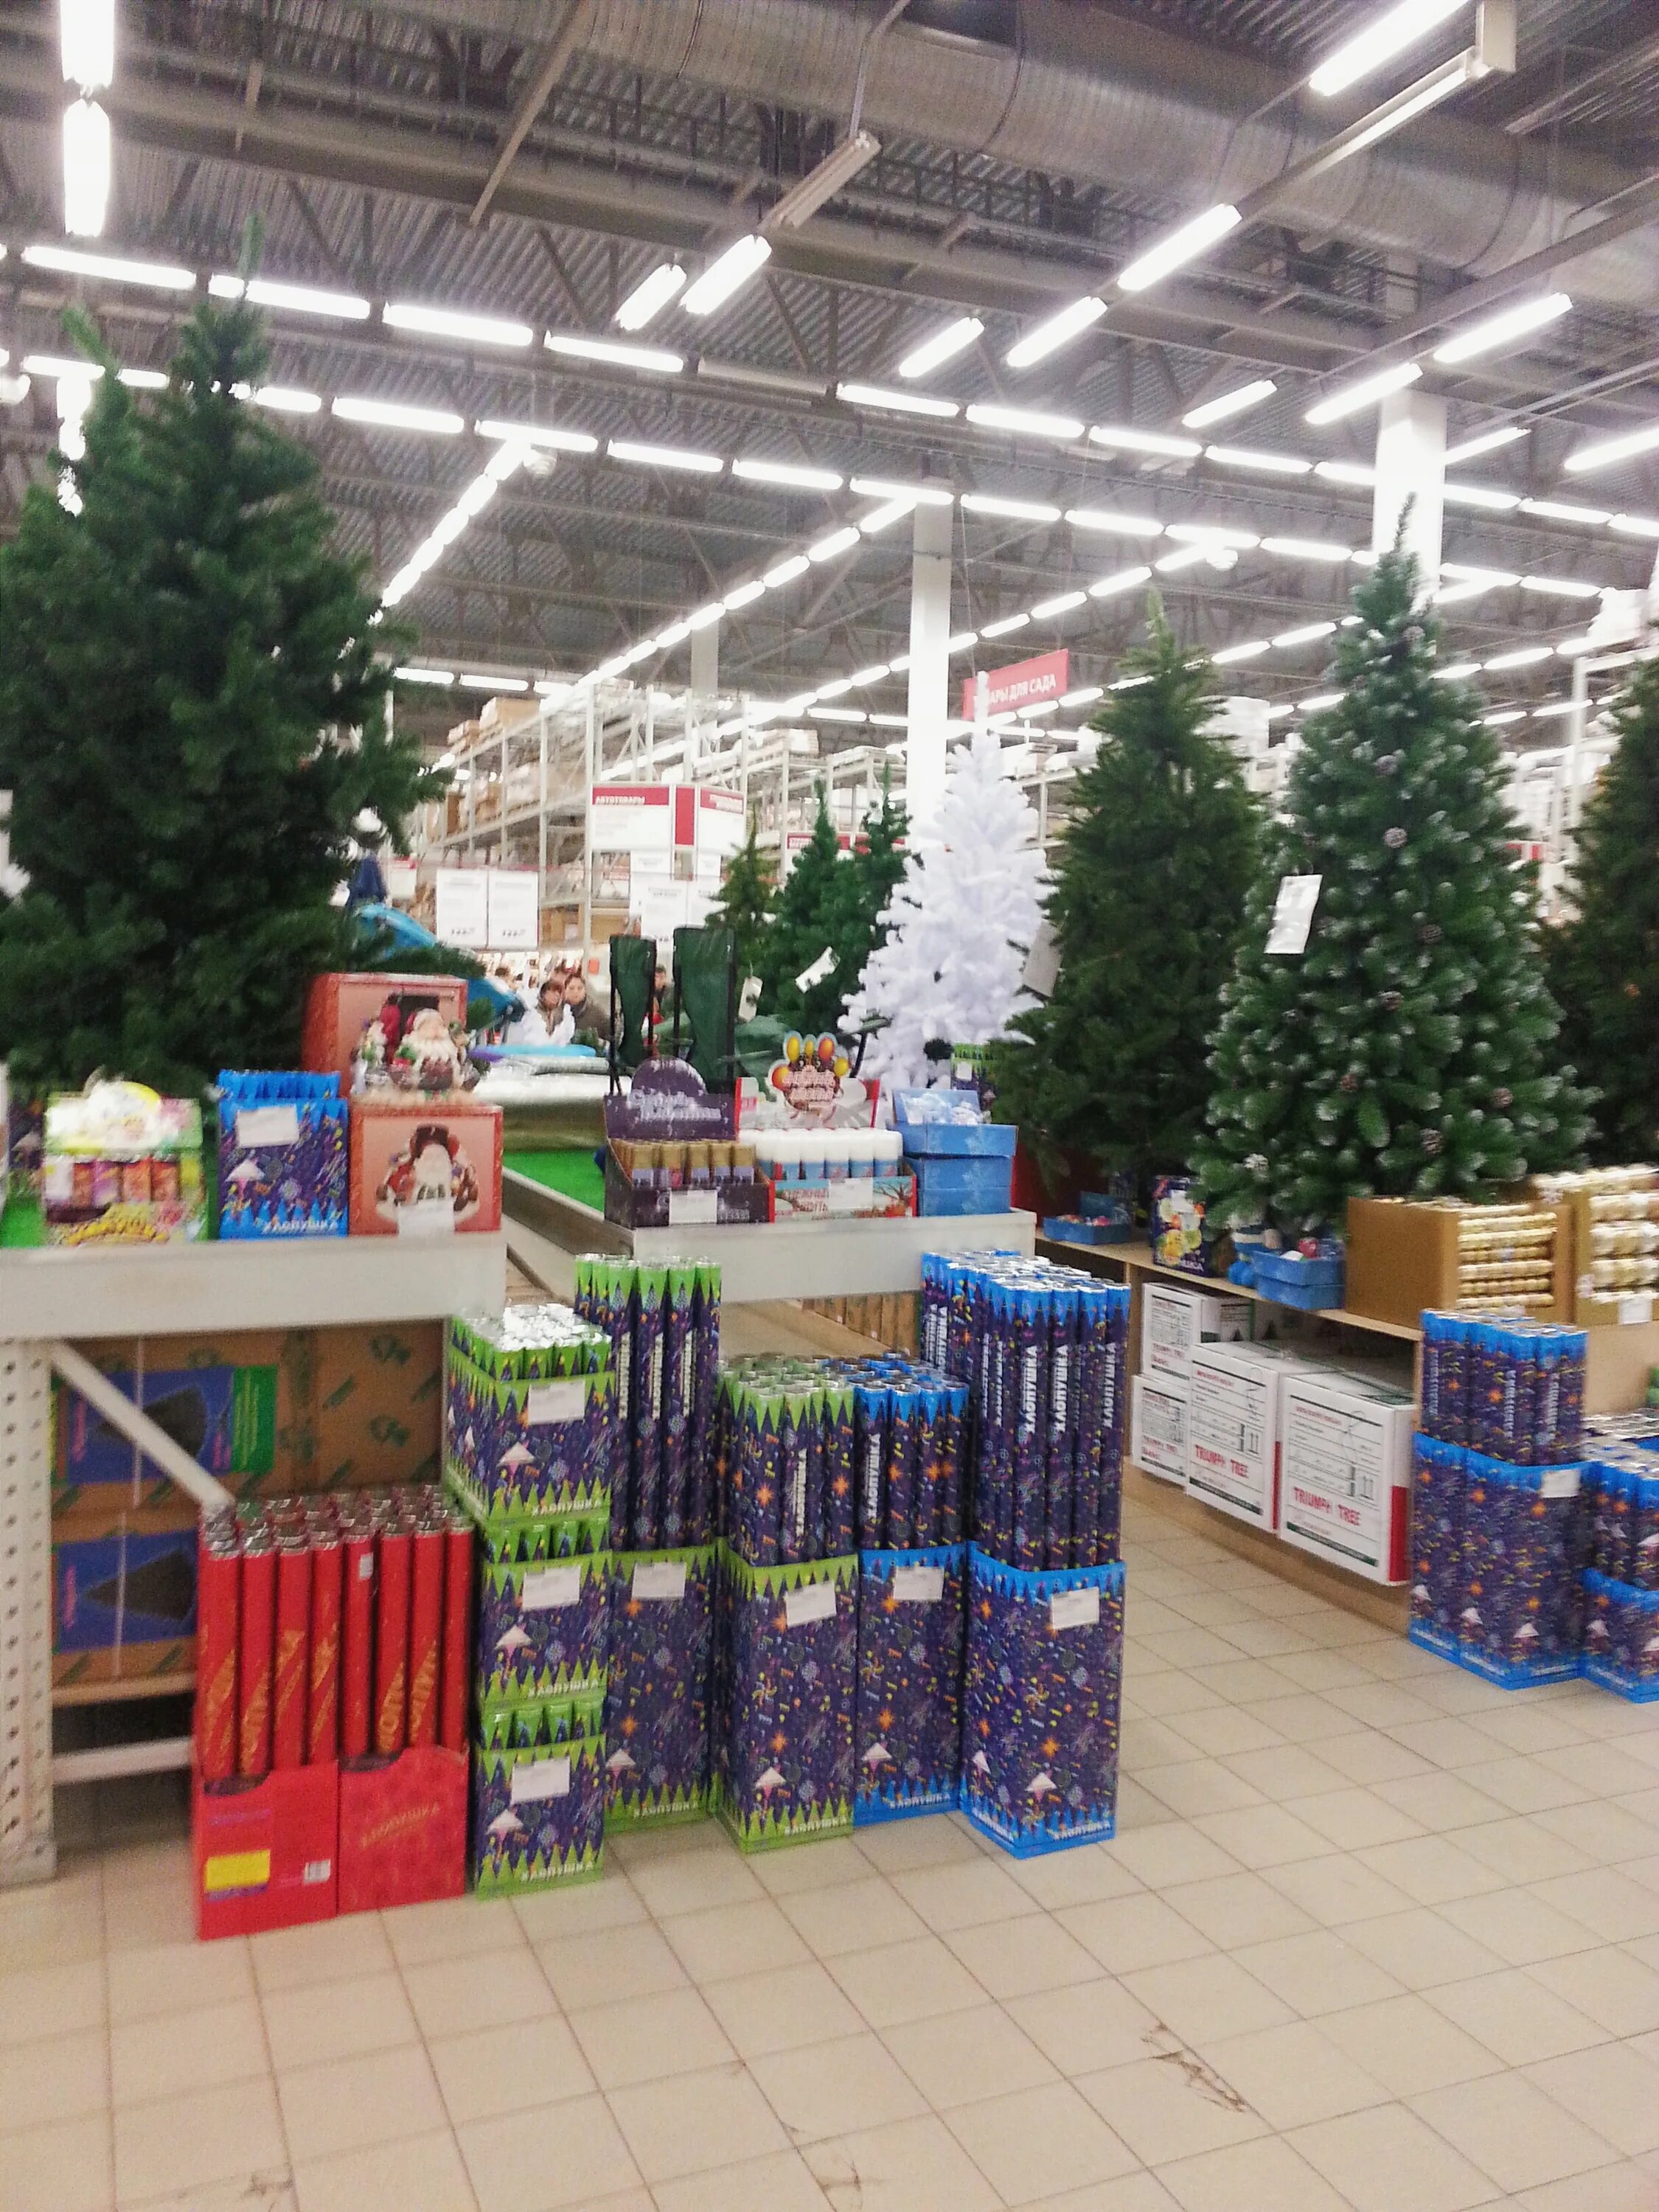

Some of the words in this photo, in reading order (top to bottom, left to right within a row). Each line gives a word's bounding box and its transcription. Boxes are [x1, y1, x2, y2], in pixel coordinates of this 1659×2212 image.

[1029, 673, 1056, 693] САДА
[1025, 1345, 1037, 1434] ХЛОПУШКА
[1055, 1345, 1068, 1433] ХЛОПУШКА
[1102, 1342, 1116, 1429] ХЛОПУШКА
[867, 1433, 880, 1520] ХЛОПУШКА
[1338, 1504, 1360, 1526] TREE
